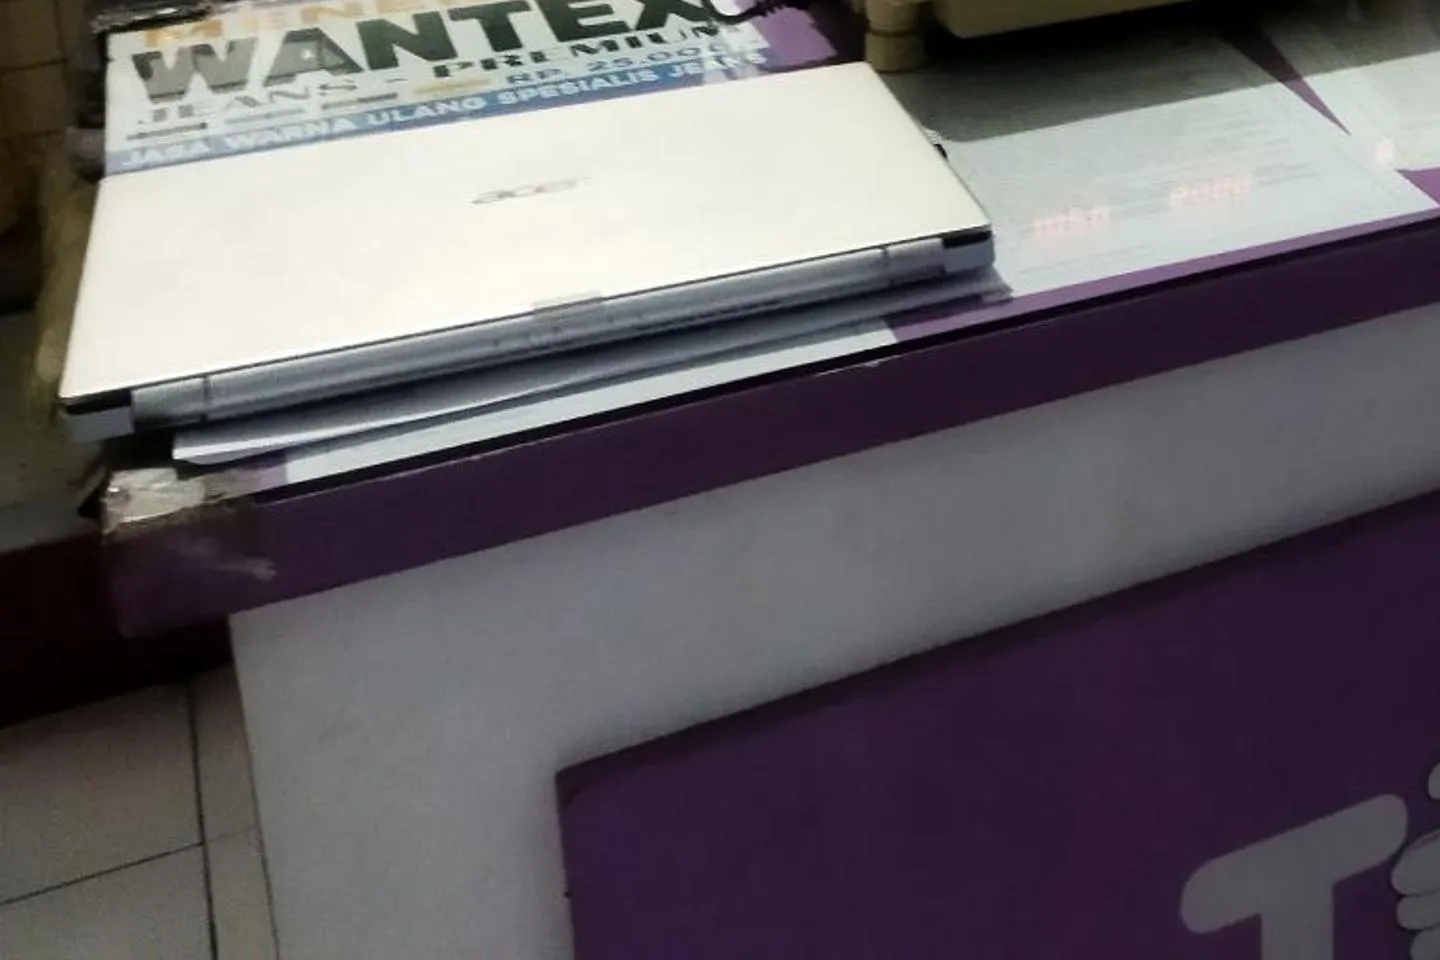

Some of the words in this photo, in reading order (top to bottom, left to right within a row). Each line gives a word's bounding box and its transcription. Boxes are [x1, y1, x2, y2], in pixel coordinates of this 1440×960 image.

[122, 139, 211, 167] JASA
[223, 117, 358, 149] WARNA
[366, 96, 488, 125] ULANG
[496, 68, 661, 105] SPESIALIS
